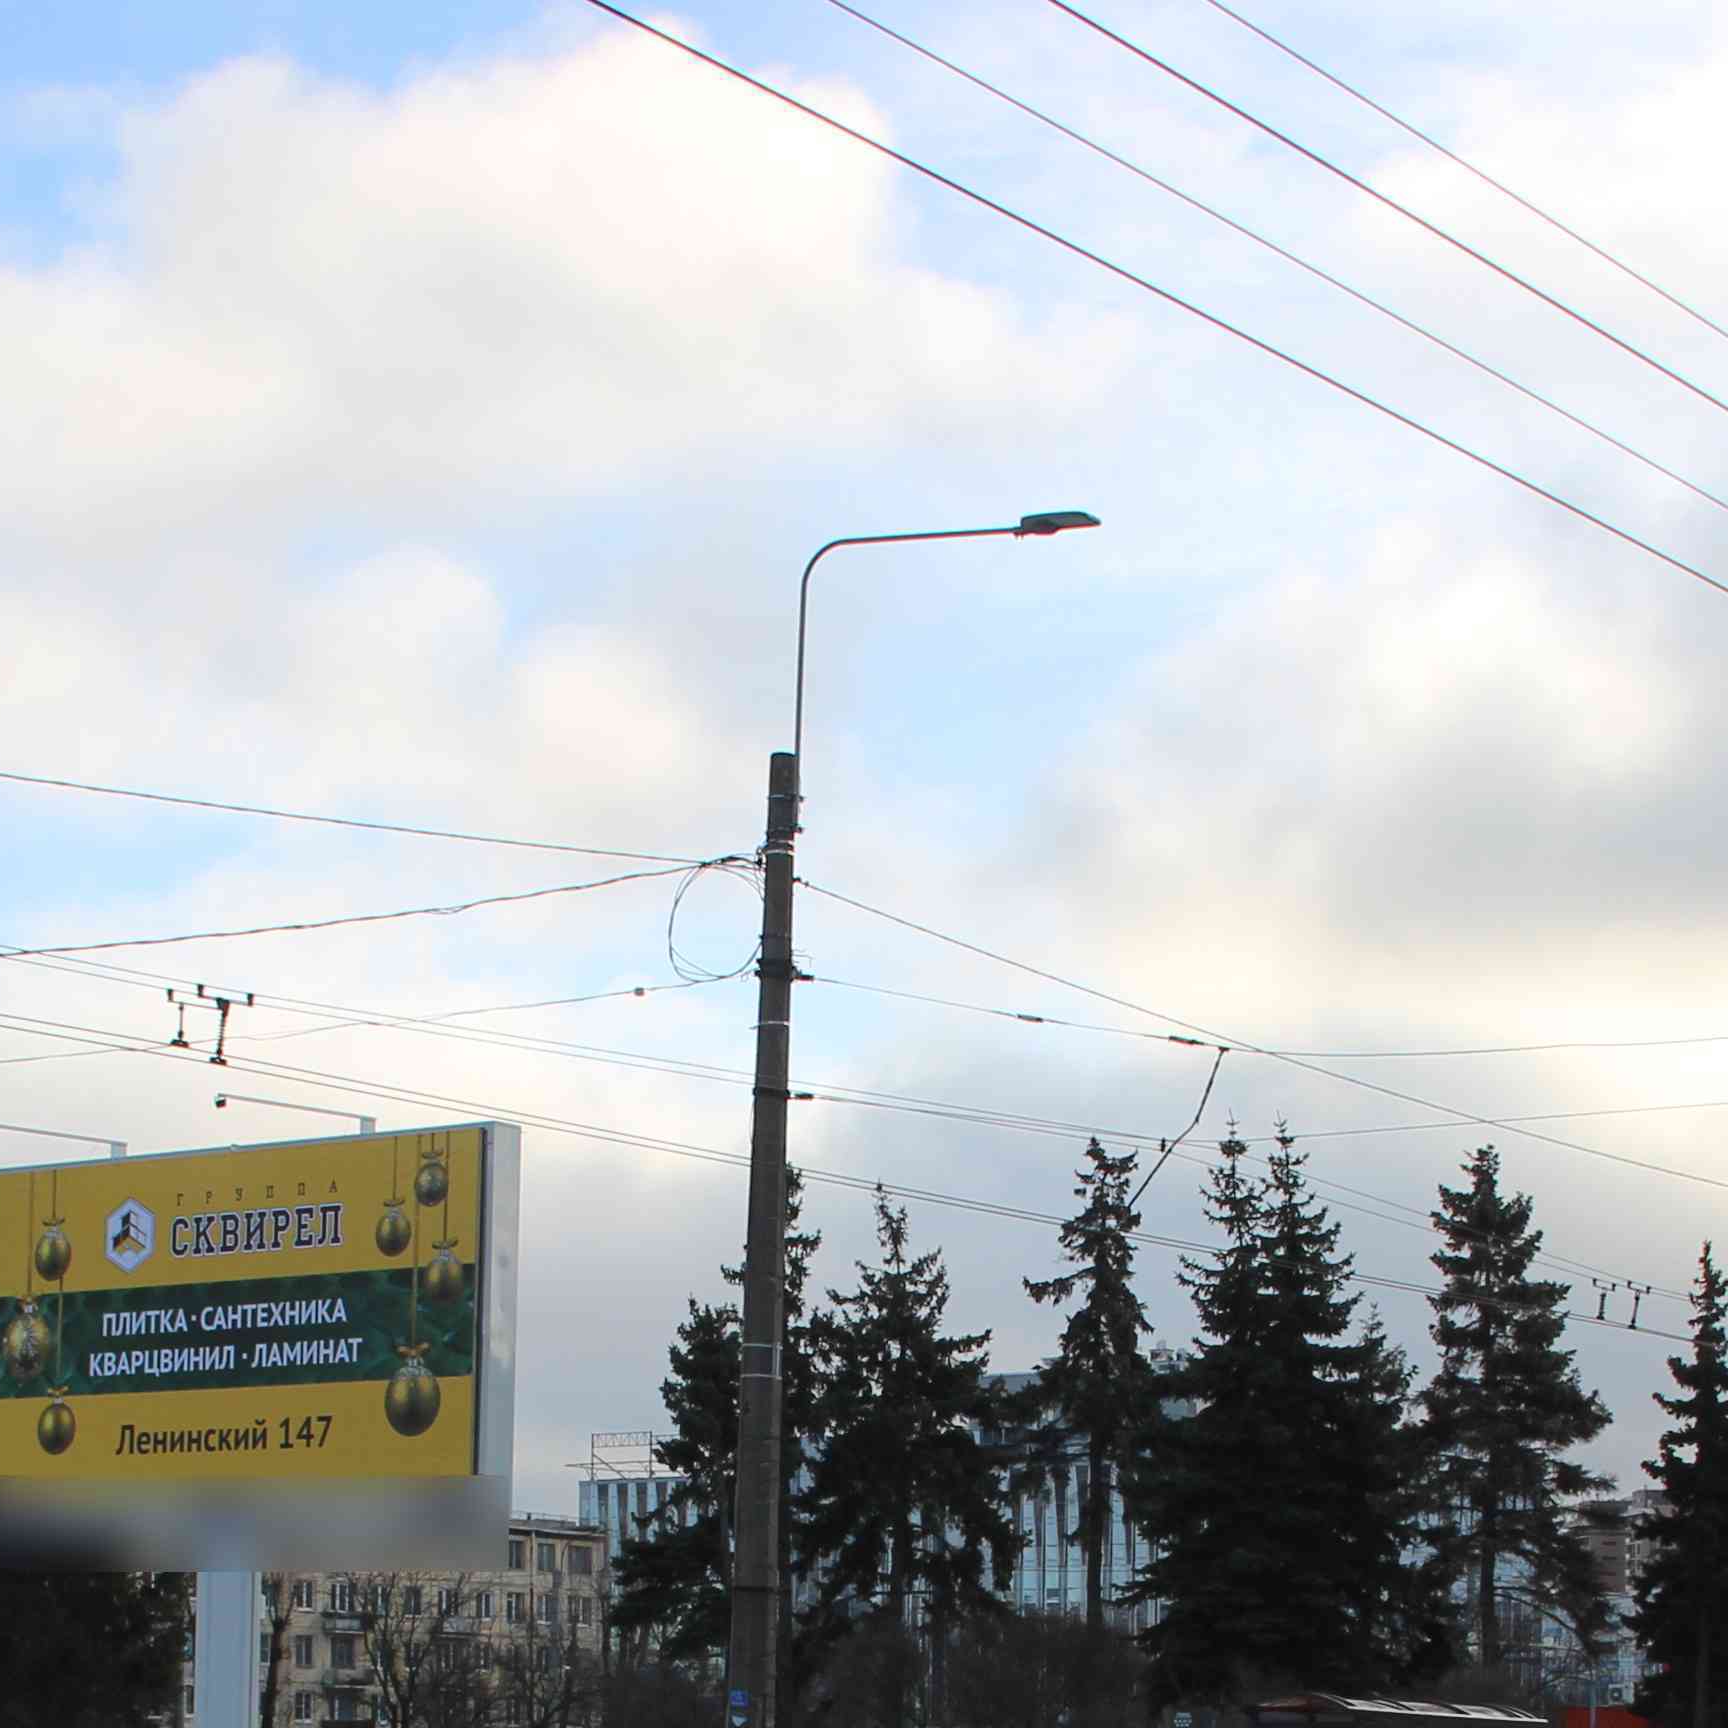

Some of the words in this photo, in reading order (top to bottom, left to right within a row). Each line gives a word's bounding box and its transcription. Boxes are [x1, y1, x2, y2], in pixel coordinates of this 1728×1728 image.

[176, 1179, 338, 1207] ГРУППА
[171, 1204, 343, 1257] СКВИРЕЛ
[102, 1308, 188, 1337] ПЛИТКА
[200, 1297, 347, 1331] САНТЕХНИКА
[89, 1345, 235, 1377] КВАРЦВИНИЛ
[251, 1338, 363, 1368] ЛАМИНАТ
[115, 1419, 268, 1456] Ленинский
[279, 1415, 333, 1449] 147
